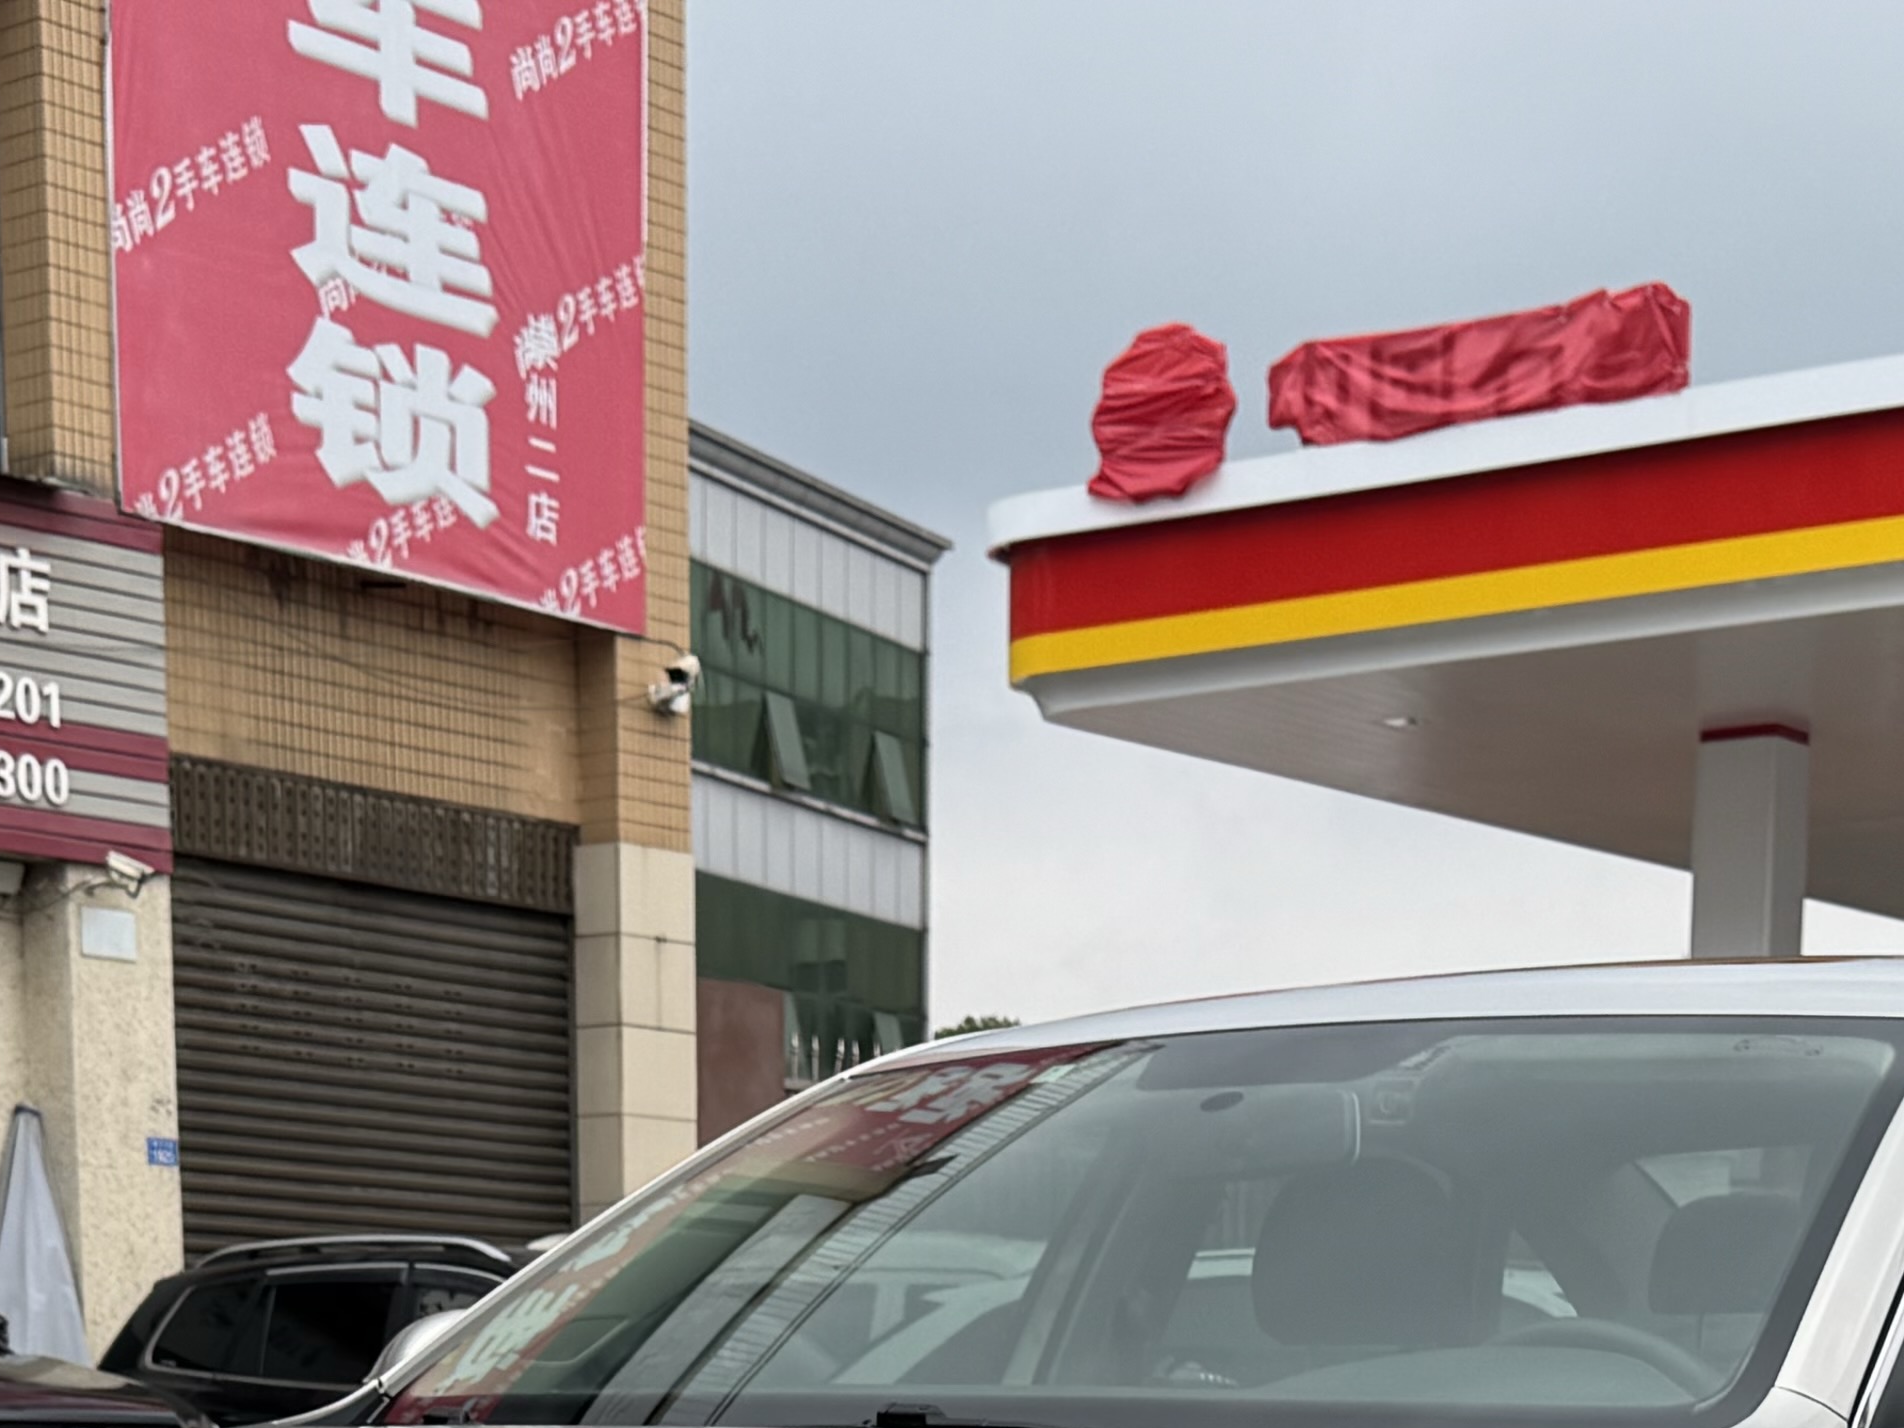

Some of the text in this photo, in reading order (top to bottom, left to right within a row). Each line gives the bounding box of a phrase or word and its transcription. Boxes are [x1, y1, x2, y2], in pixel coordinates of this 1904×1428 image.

[509, 0, 642, 101] 尚尚2手车连
[287, 0, 499, 530] 车连锁
